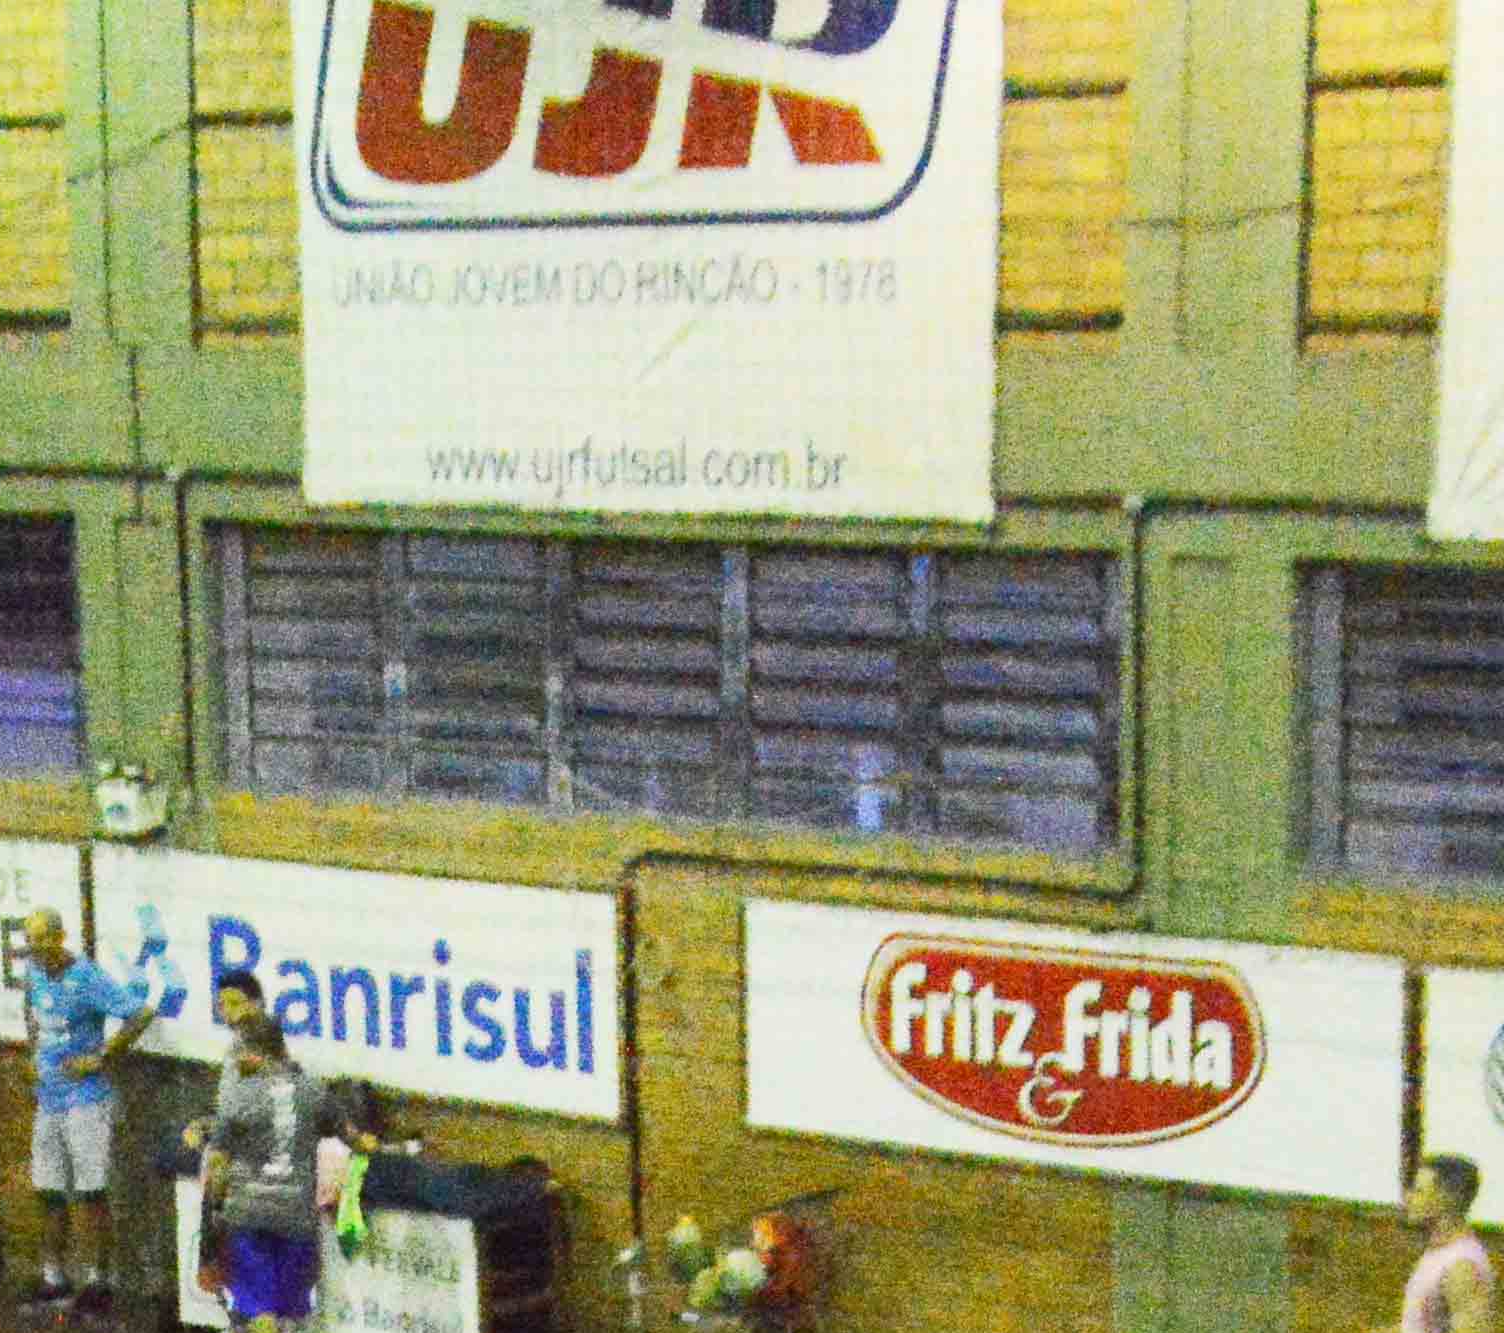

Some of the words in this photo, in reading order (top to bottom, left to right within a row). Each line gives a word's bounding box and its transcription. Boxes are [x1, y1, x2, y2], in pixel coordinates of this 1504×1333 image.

[450, 260, 562, 307] JOVEM
[573, 259, 626, 307] DO
[208, 912, 596, 1074] Banrisul
[1018, 1052, 1083, 1127] &
